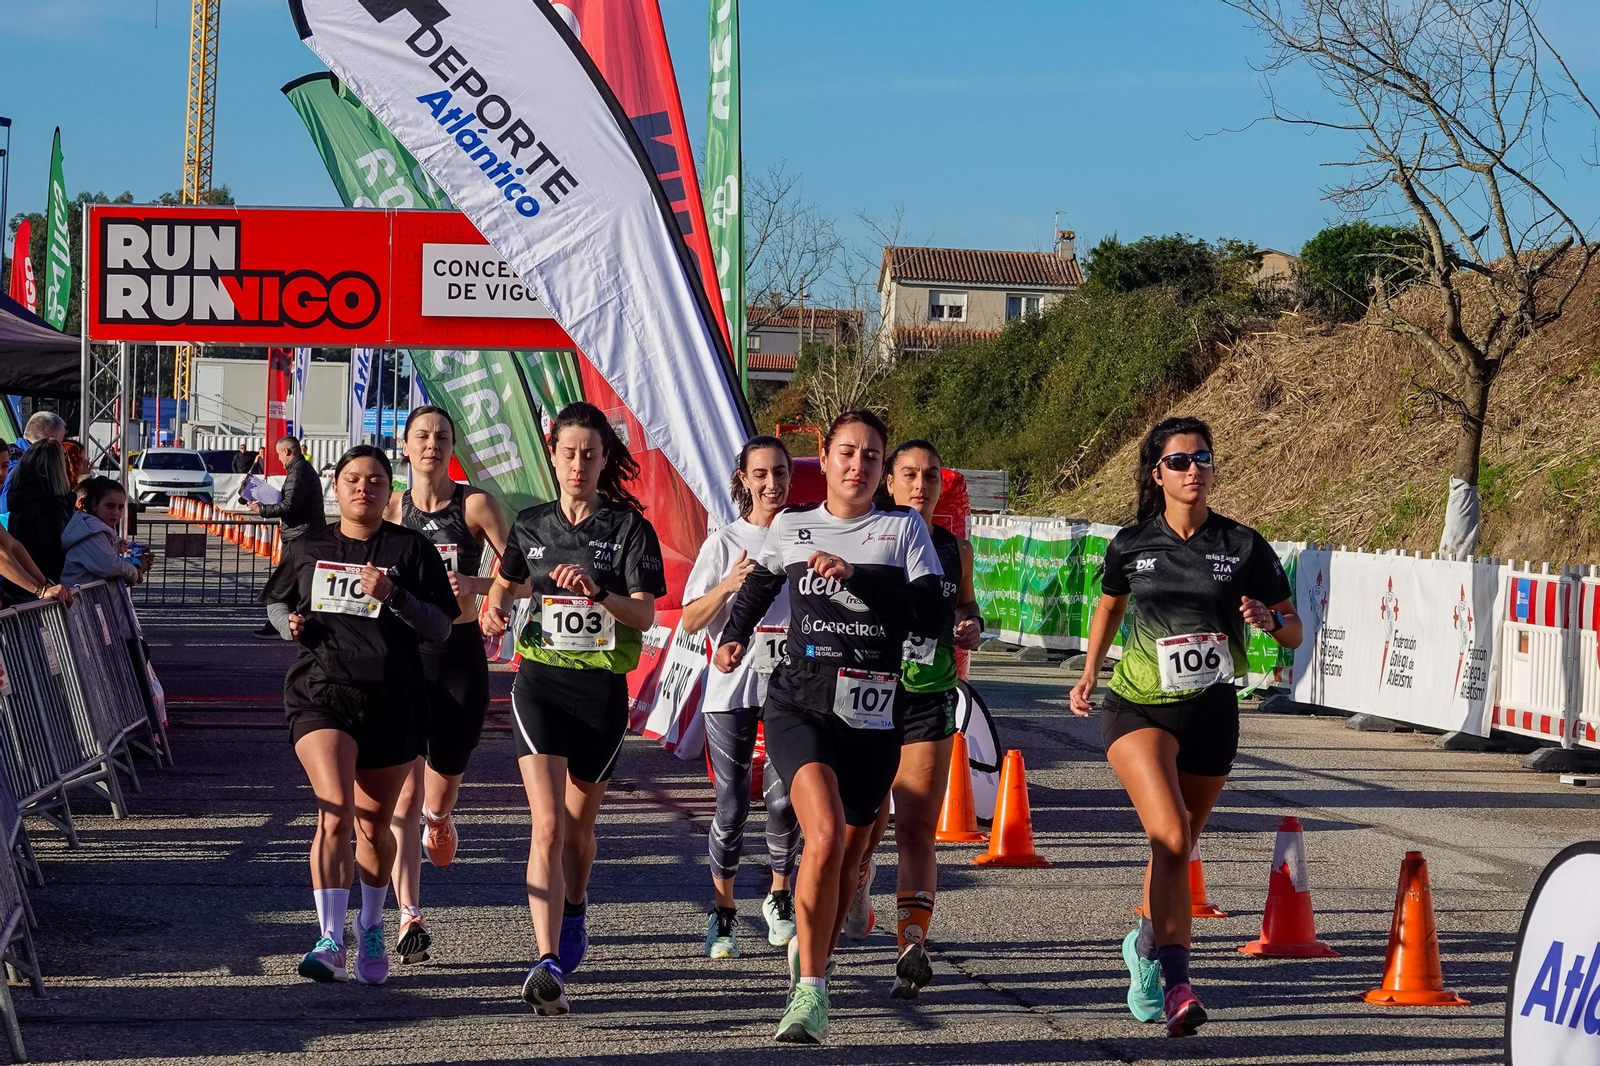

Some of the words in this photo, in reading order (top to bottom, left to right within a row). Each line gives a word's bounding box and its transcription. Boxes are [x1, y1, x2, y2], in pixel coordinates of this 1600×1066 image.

[405, 23, 578, 206] DEPORTE
[416, 89, 541, 218] Atlántico
[107, 223, 236, 271] RUN
[433, 259, 519, 278] CONCE
[24, 257, 36, 314] IGO
[448, 283, 477, 300] DE
[527, 547, 547, 557] DK
[1136, 558, 1157, 569] DK
[593, 562, 612, 572] VIGO
[1212, 574, 1233, 583] VIGO
[326, 577, 366, 599] 110
[553, 611, 602, 635] 103
[1169, 647, 1221, 674] 106
[849, 686, 893, 713] 107
